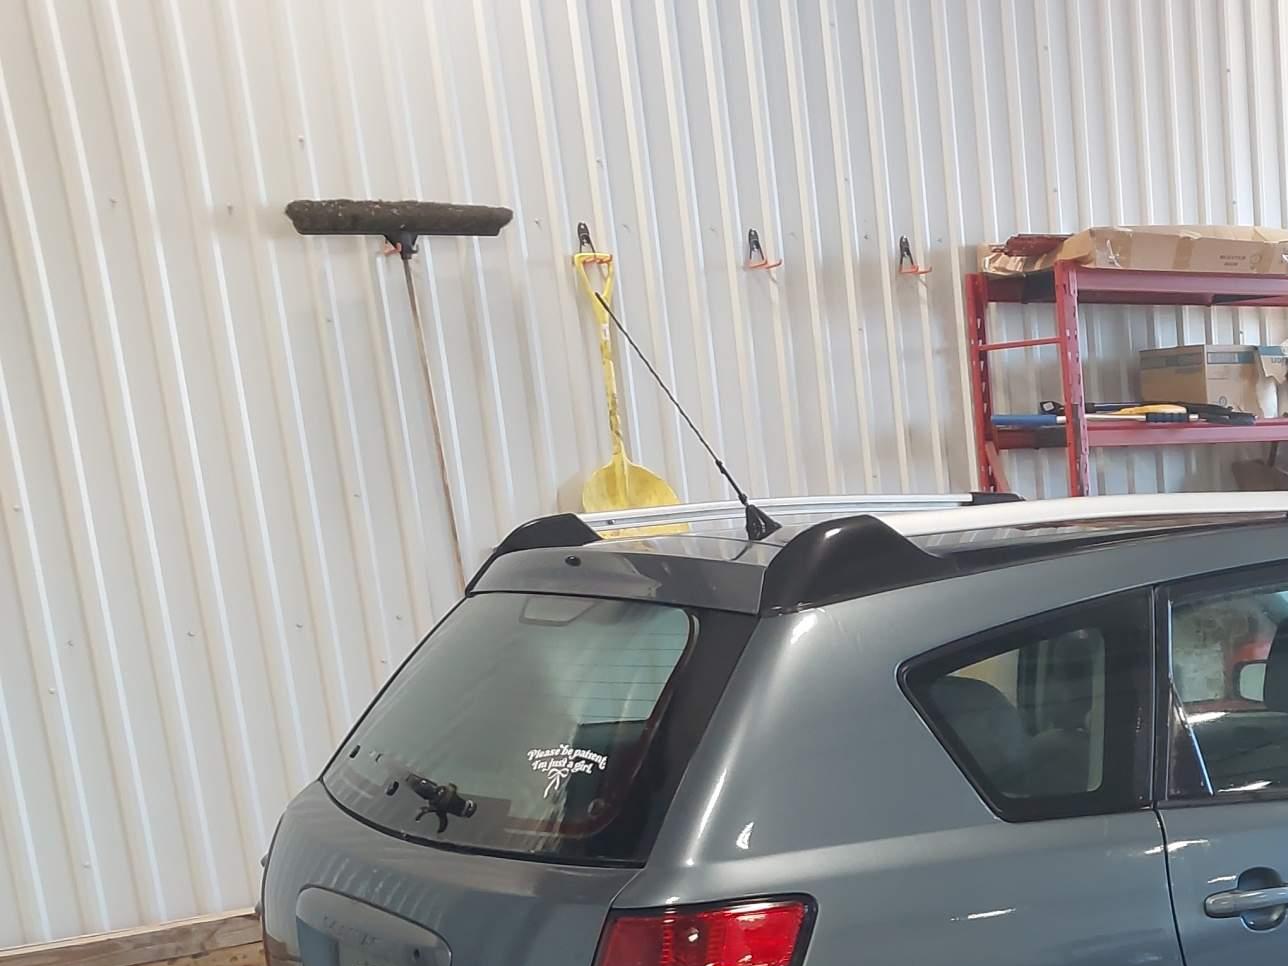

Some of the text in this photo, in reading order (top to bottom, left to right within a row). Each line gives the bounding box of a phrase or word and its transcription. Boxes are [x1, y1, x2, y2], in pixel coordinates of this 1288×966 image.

[527, 747, 561, 761] Please
[559, 743, 574, 758] be
[547, 757, 568, 771] just
[571, 760, 594, 774] girl
